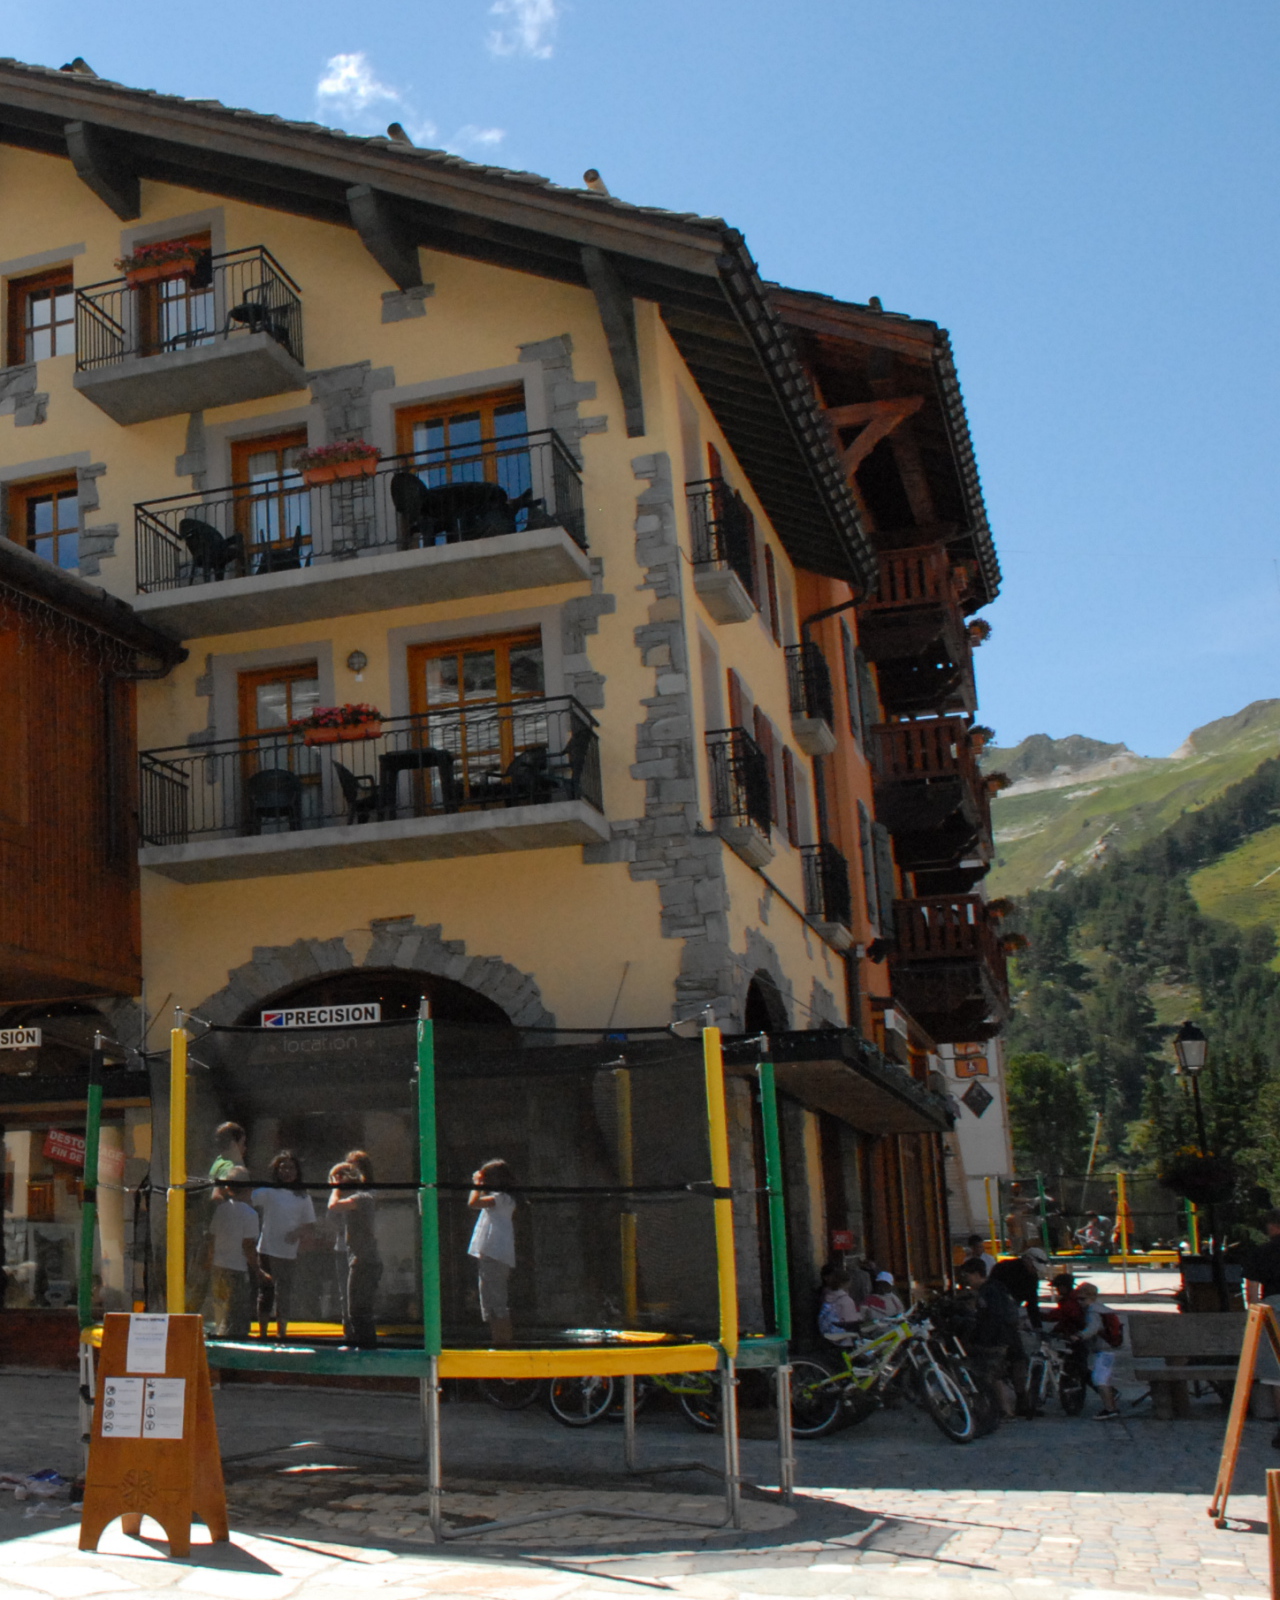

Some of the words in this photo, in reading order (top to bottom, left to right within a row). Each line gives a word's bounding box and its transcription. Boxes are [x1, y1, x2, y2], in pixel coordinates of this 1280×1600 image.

[284, 1005, 377, 1026] PRECISION
[282, 1034, 358, 1054] location
[51, 1146, 68, 1158] FIN
[69, 1152, 84, 1163] DE
